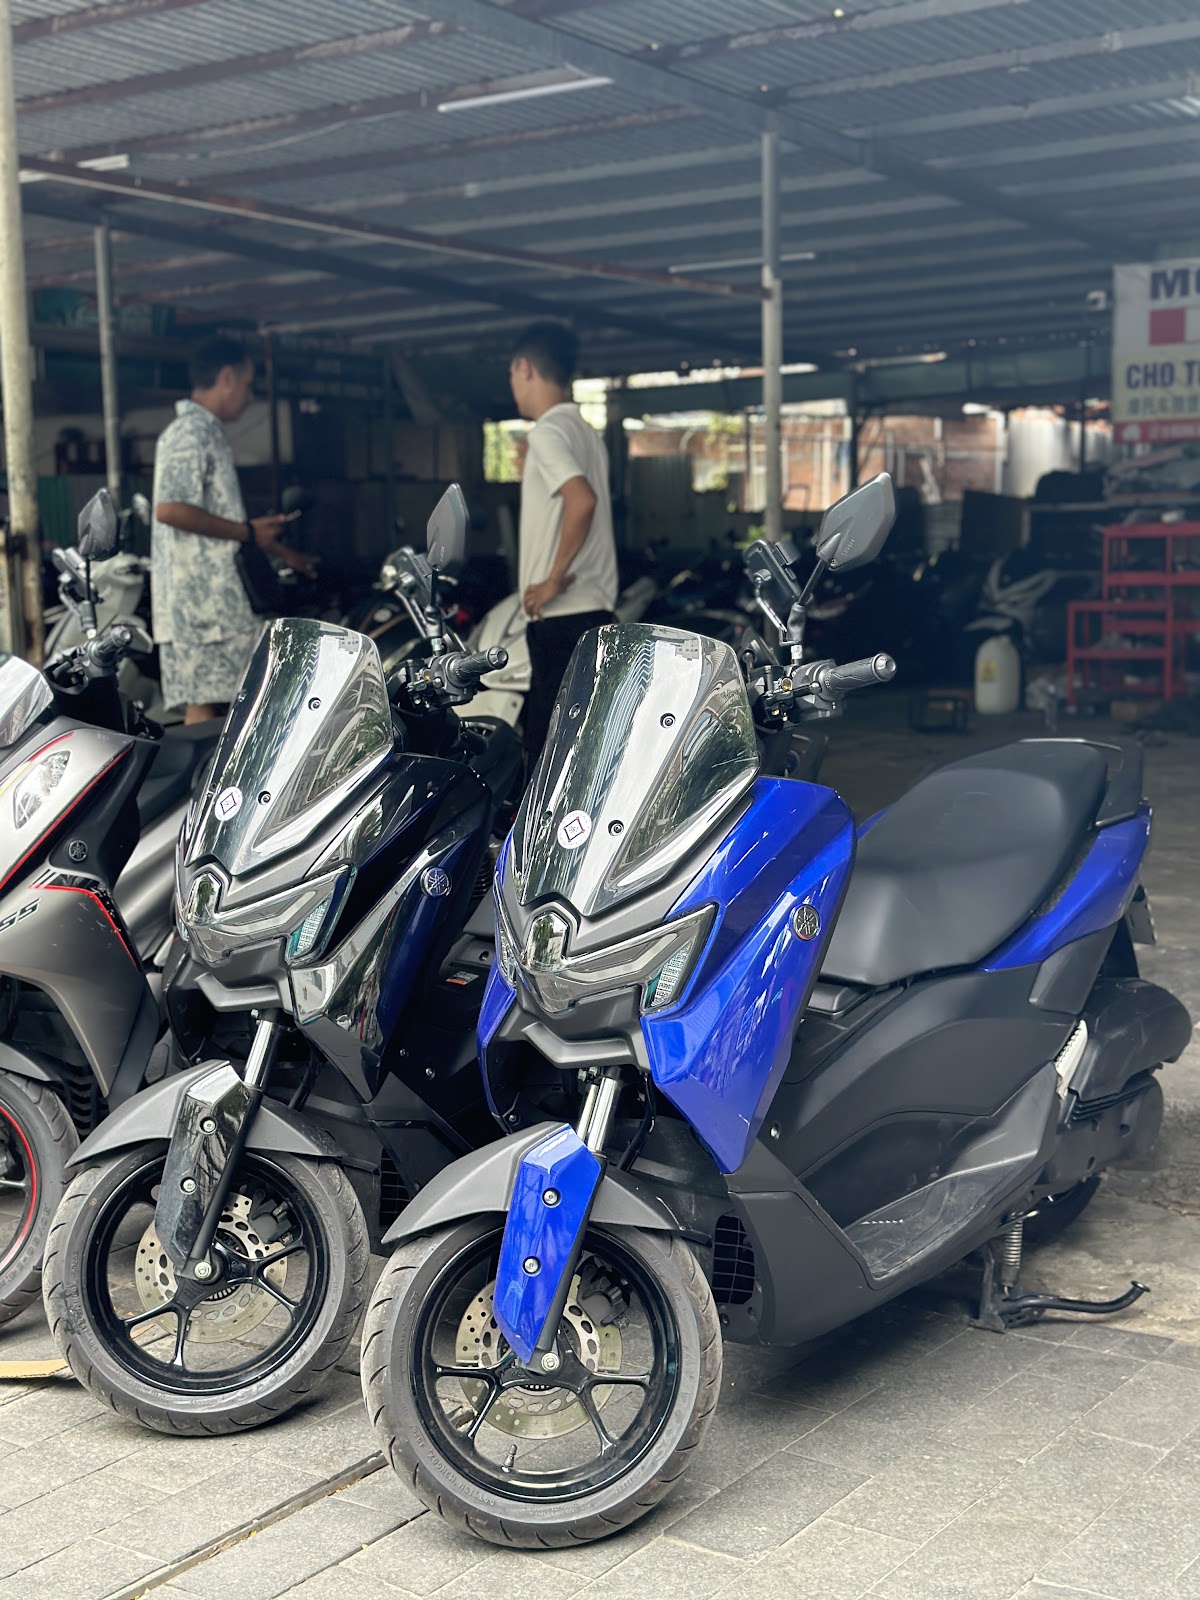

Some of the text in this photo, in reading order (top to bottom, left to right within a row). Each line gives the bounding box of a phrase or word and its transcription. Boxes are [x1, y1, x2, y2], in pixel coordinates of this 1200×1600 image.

[1151, 267, 1200, 300] M
[1126, 359, 1200, 390] CHO T
